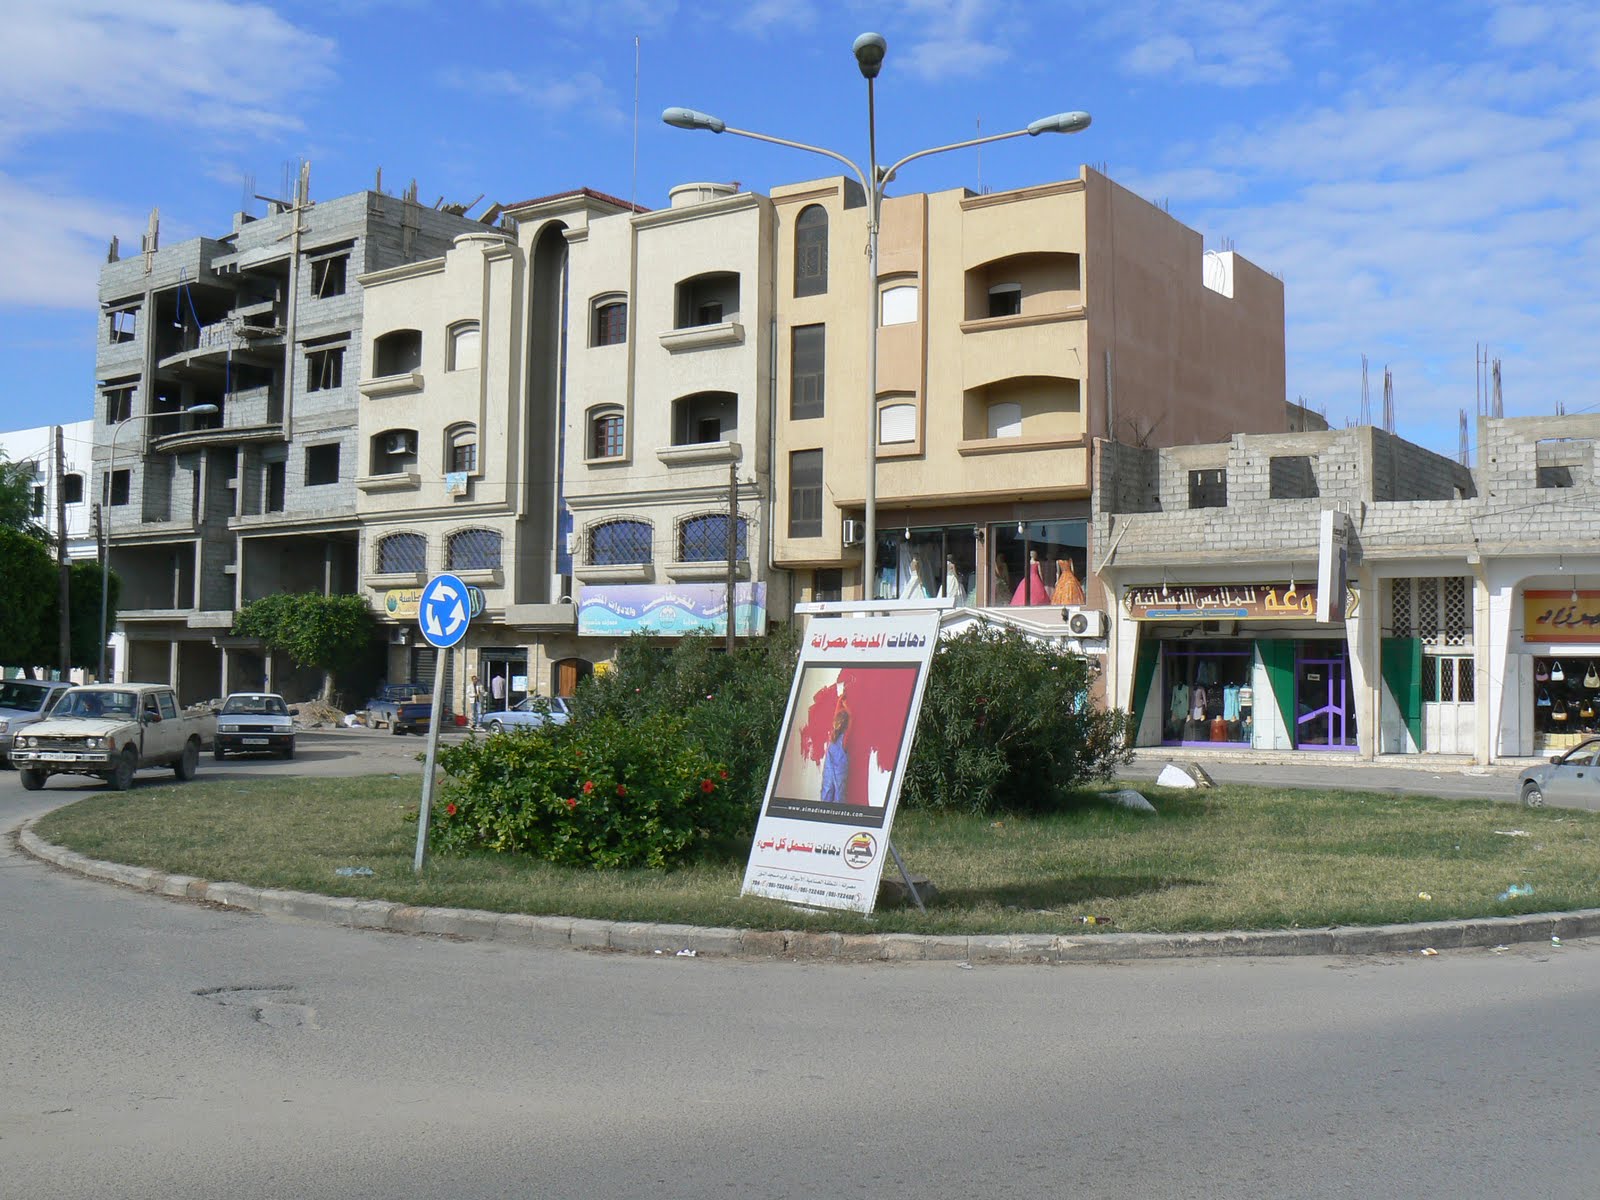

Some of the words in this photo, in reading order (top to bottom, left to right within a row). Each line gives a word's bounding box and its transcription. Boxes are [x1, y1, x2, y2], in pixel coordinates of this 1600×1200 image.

[1260, 586, 1319, 616] وعة
[811, 633, 848, 651] مصراتة
[851, 633, 886, 651] المدينة
[887, 632, 926, 648] دهانات
[757, 837, 774, 852] شيء
[775, 837, 787, 851] كل
[786, 839, 814, 853] تتحمل
[815, 843, 841, 856] دهانات
